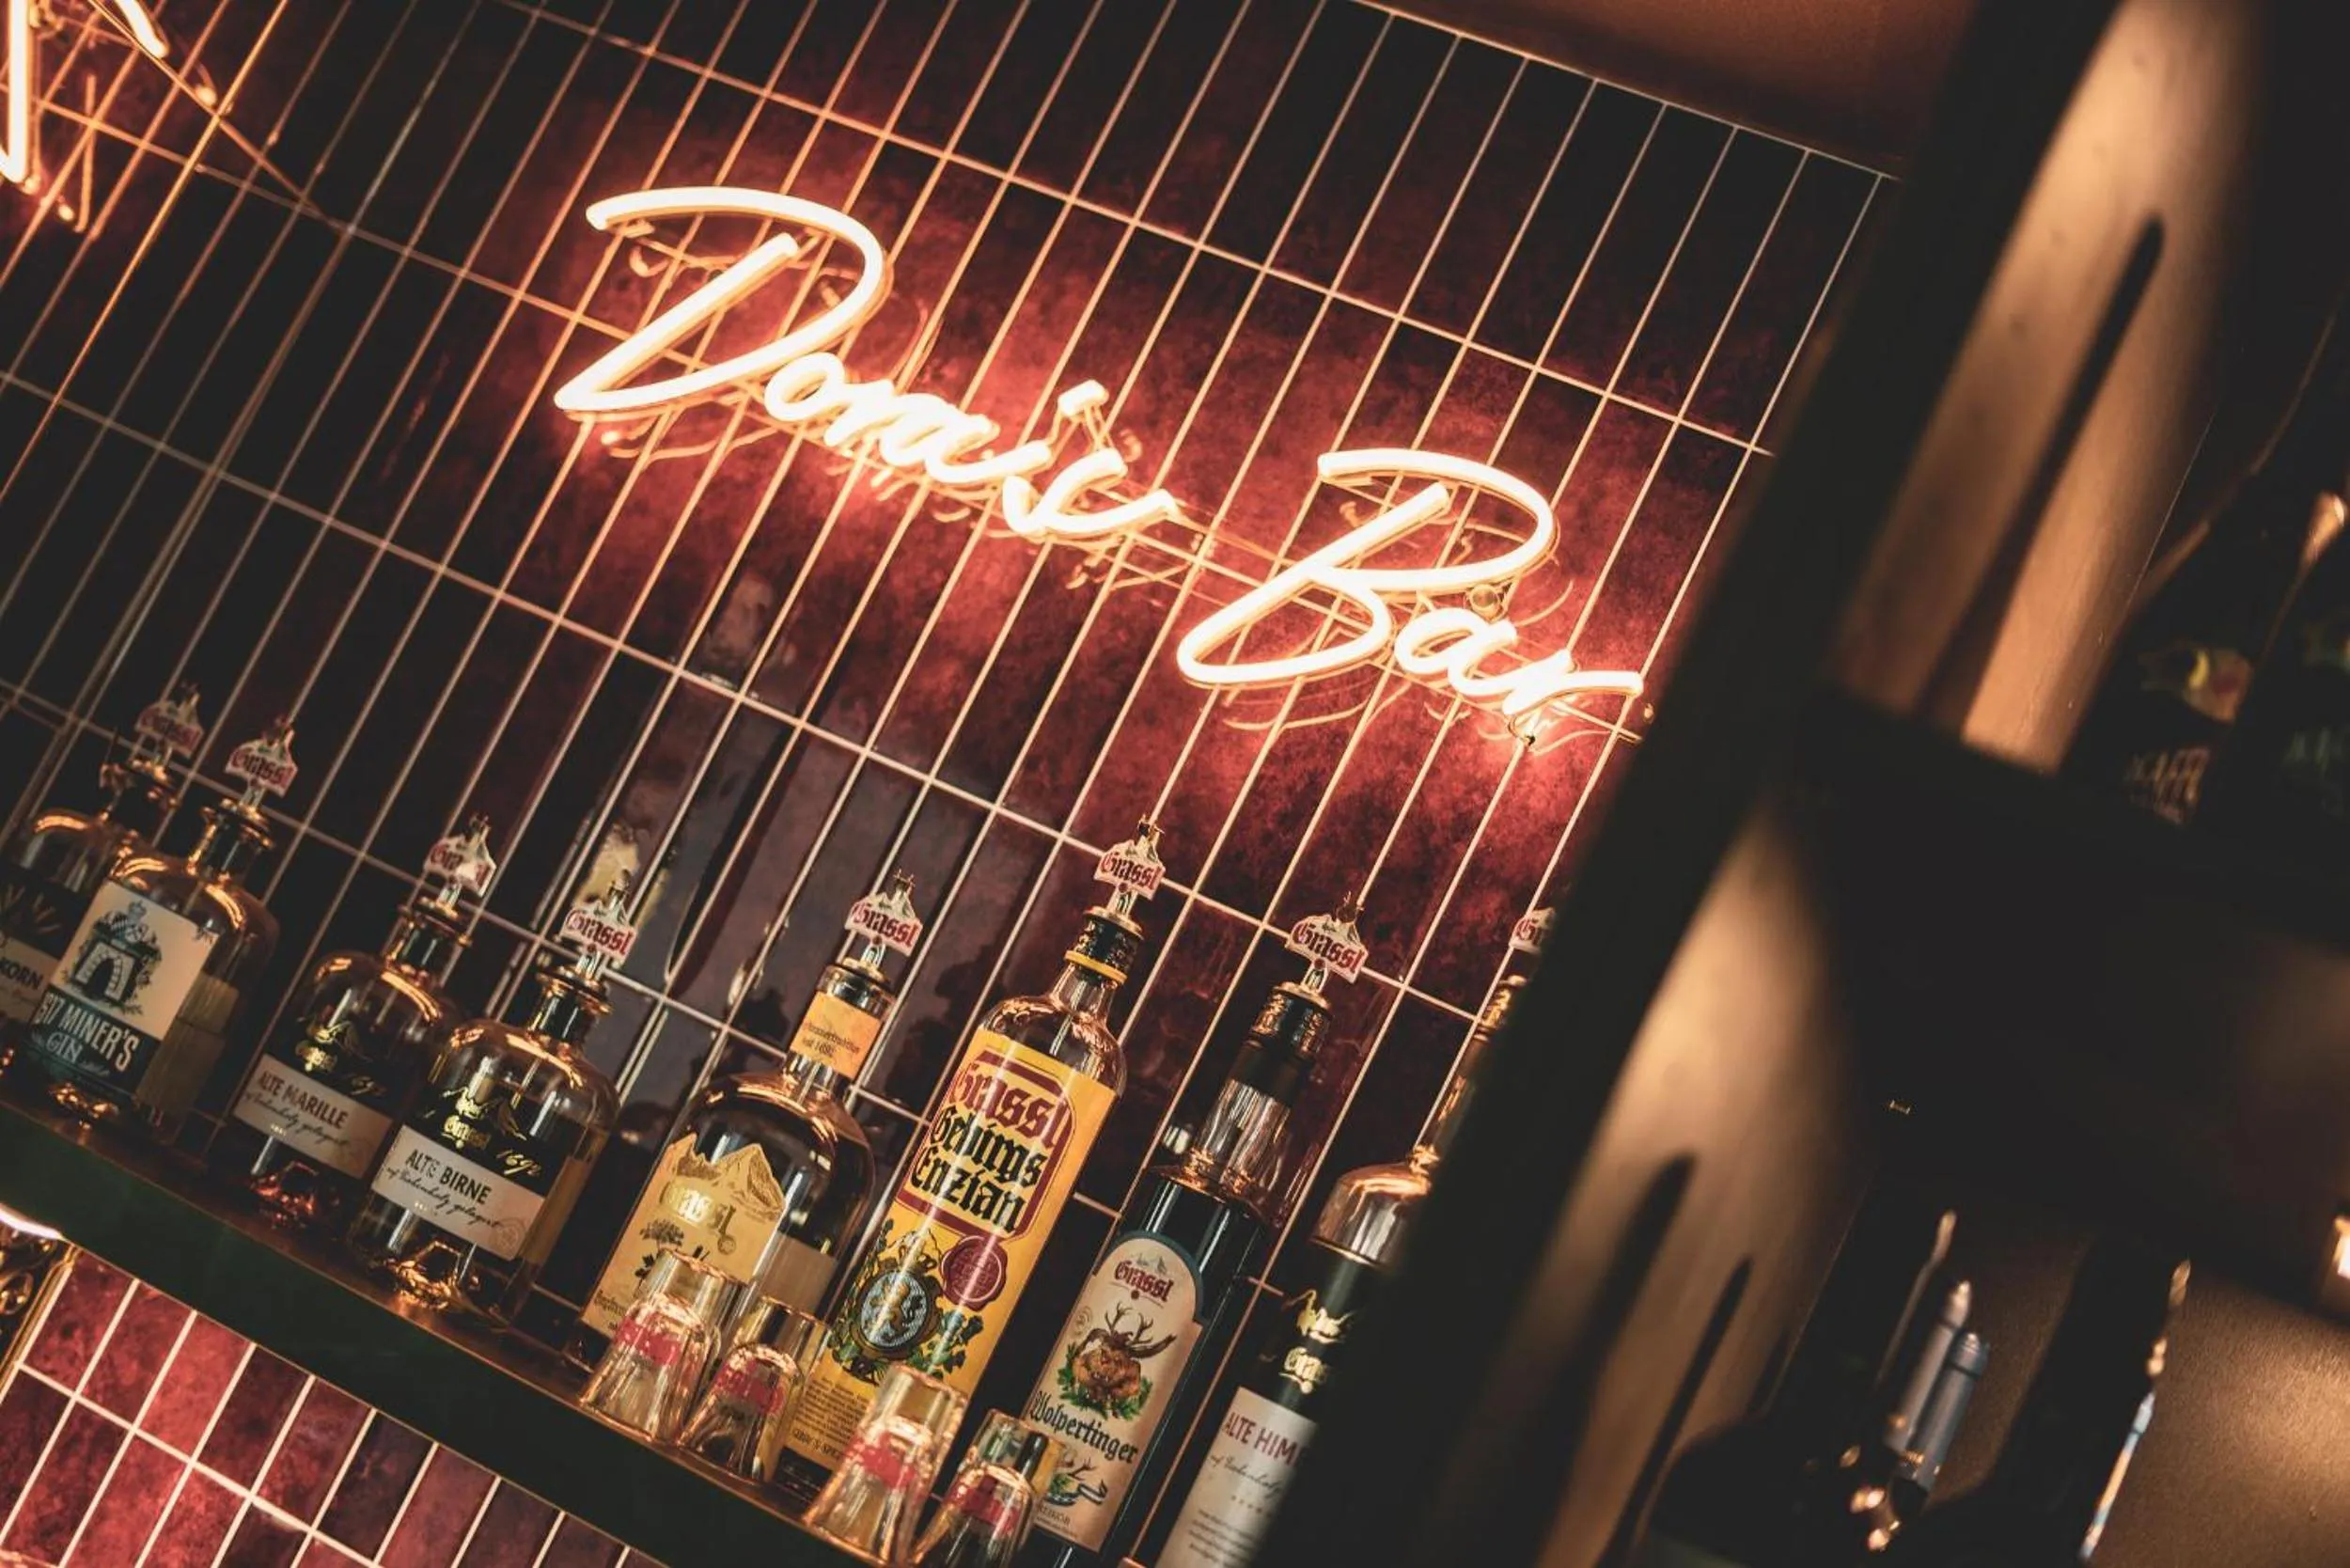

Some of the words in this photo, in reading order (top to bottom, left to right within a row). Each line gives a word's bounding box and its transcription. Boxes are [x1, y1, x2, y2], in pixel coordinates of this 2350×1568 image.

[1175, 447, 1646, 716] Bar
[1100, 851, 1162, 890] Grassl
[566, 909, 631, 956] Grassl
[852, 902, 917, 948] Grassl
[1291, 921, 1365, 974] Grassl
[47, 1032, 84, 1064] GIN
[57, 1003, 140, 1073] MINER'S
[258, 1070, 286, 1096] ALTE
[282, 1083, 350, 1130] MARILLE
[948, 1062, 1072, 1150] Grassl
[929, 1105, 1049, 1187] Gebirgs
[405, 1149, 440, 1177] ALTE
[440, 1166, 493, 1205] BIRNE
[910, 1146, 1026, 1233] Enzian
[1114, 1260, 1174, 1303] Grassl
[1028, 1390, 1138, 1465] Wolpertinger
[1223, 1412, 1257, 1444] ALTE
